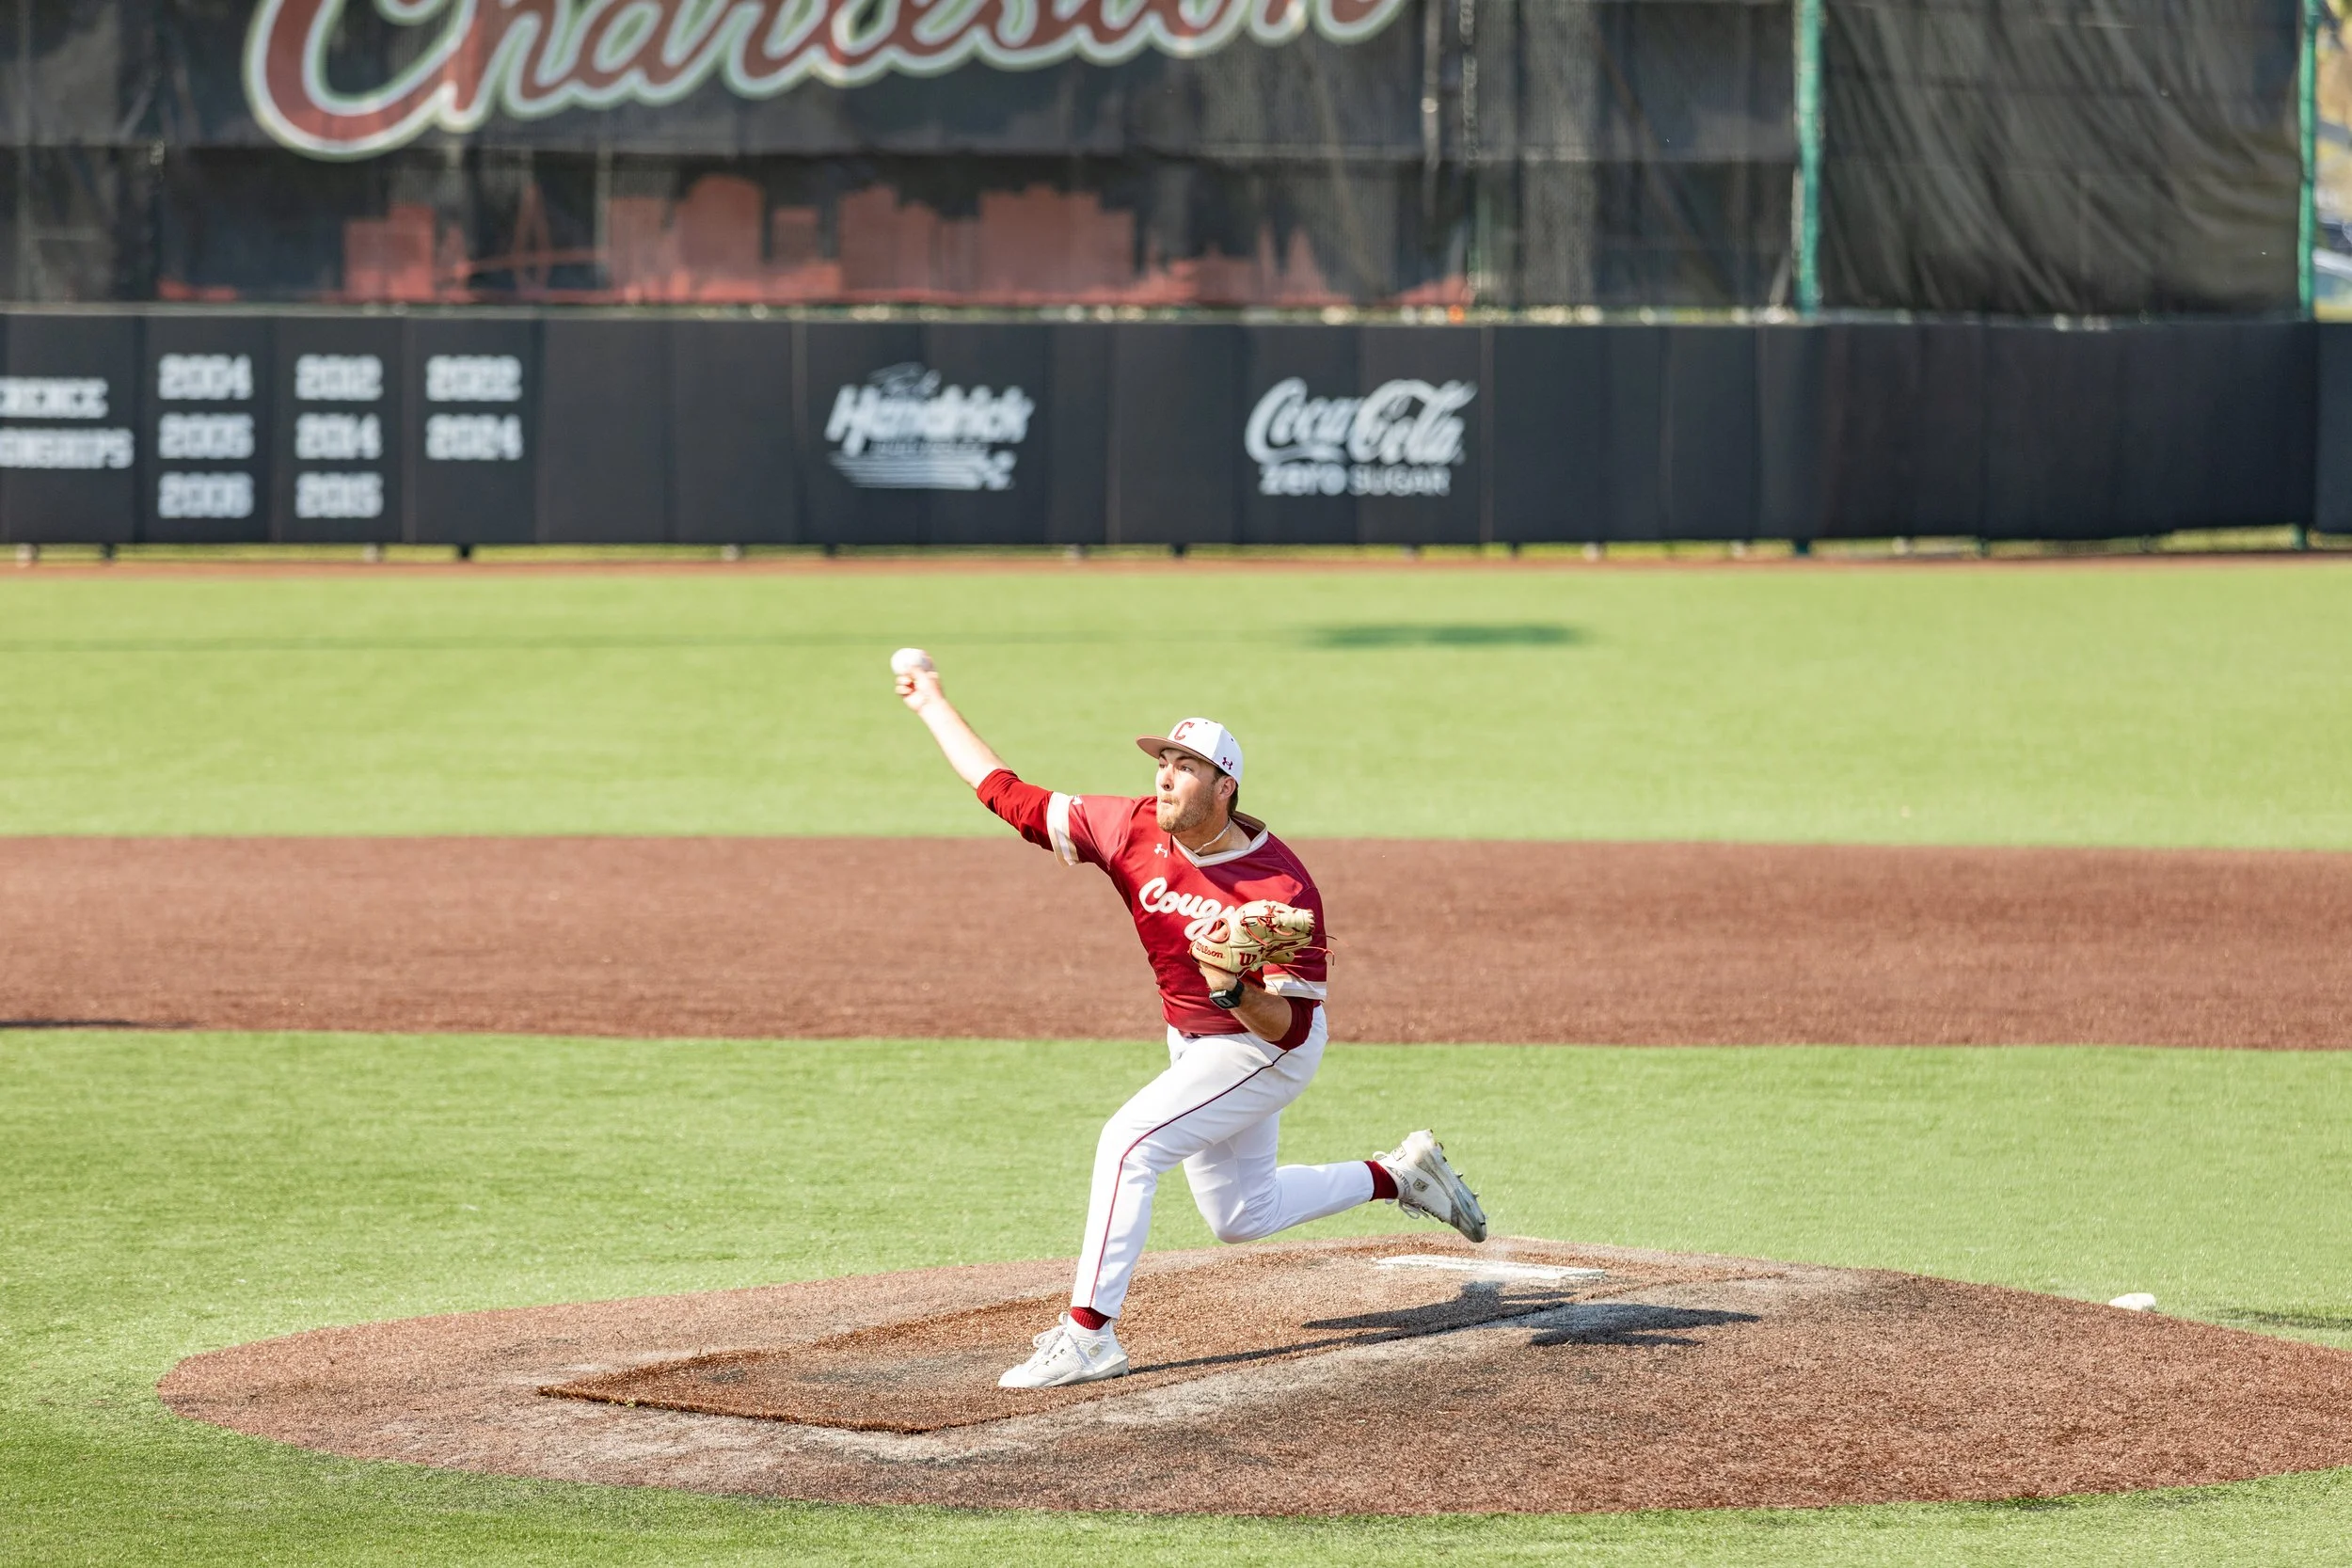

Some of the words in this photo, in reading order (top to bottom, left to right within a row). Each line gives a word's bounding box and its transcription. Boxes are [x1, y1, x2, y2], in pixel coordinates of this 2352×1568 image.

[158, 354, 253, 400] 2004
[294, 354, 384, 402] 2012
[426, 355, 522, 402] 2022
[158, 413, 255, 459] 2005
[294, 413, 383, 460] 2014
[425, 414, 524, 461] 2024
[824, 384, 1034, 457] Hendrick
[294, 472, 384, 518] 2015
[1173, 721, 1196, 740] C
[1196, 941, 1224, 959] Wilson
[1239, 952, 1258, 966] W
